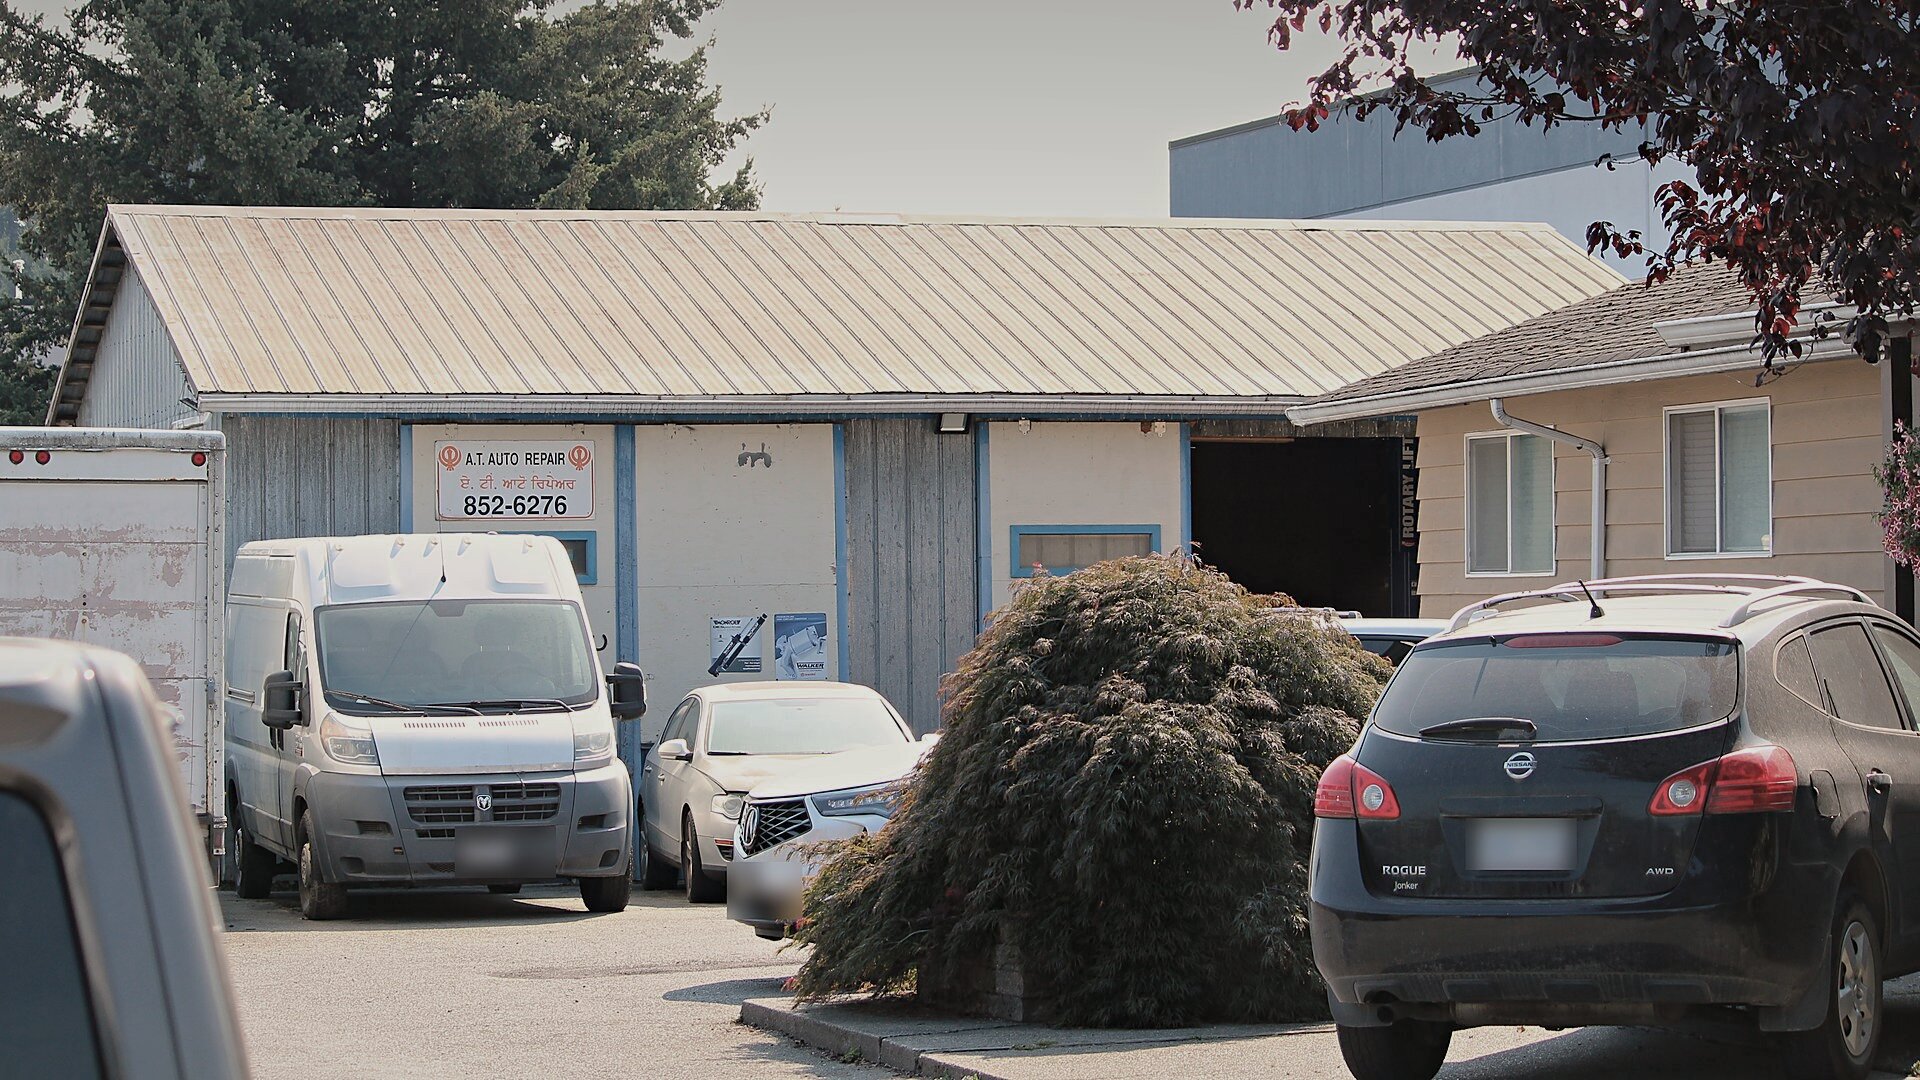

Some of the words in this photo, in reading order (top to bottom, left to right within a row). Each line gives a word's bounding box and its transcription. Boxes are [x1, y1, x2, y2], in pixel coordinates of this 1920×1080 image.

[465, 452, 485, 466] A.T.
[488, 452, 519, 466] AUTO
[525, 452, 566, 466] REPAIR
[1402, 436, 1415, 470] LIFT
[463, 495, 567, 516] 852-6276
[1402, 474, 1415, 538] ROTARY
[1382, 865, 1426, 875] ROGUE
[1645, 867, 1674, 875] AWD
[1393, 880, 1419, 892] Jonker
